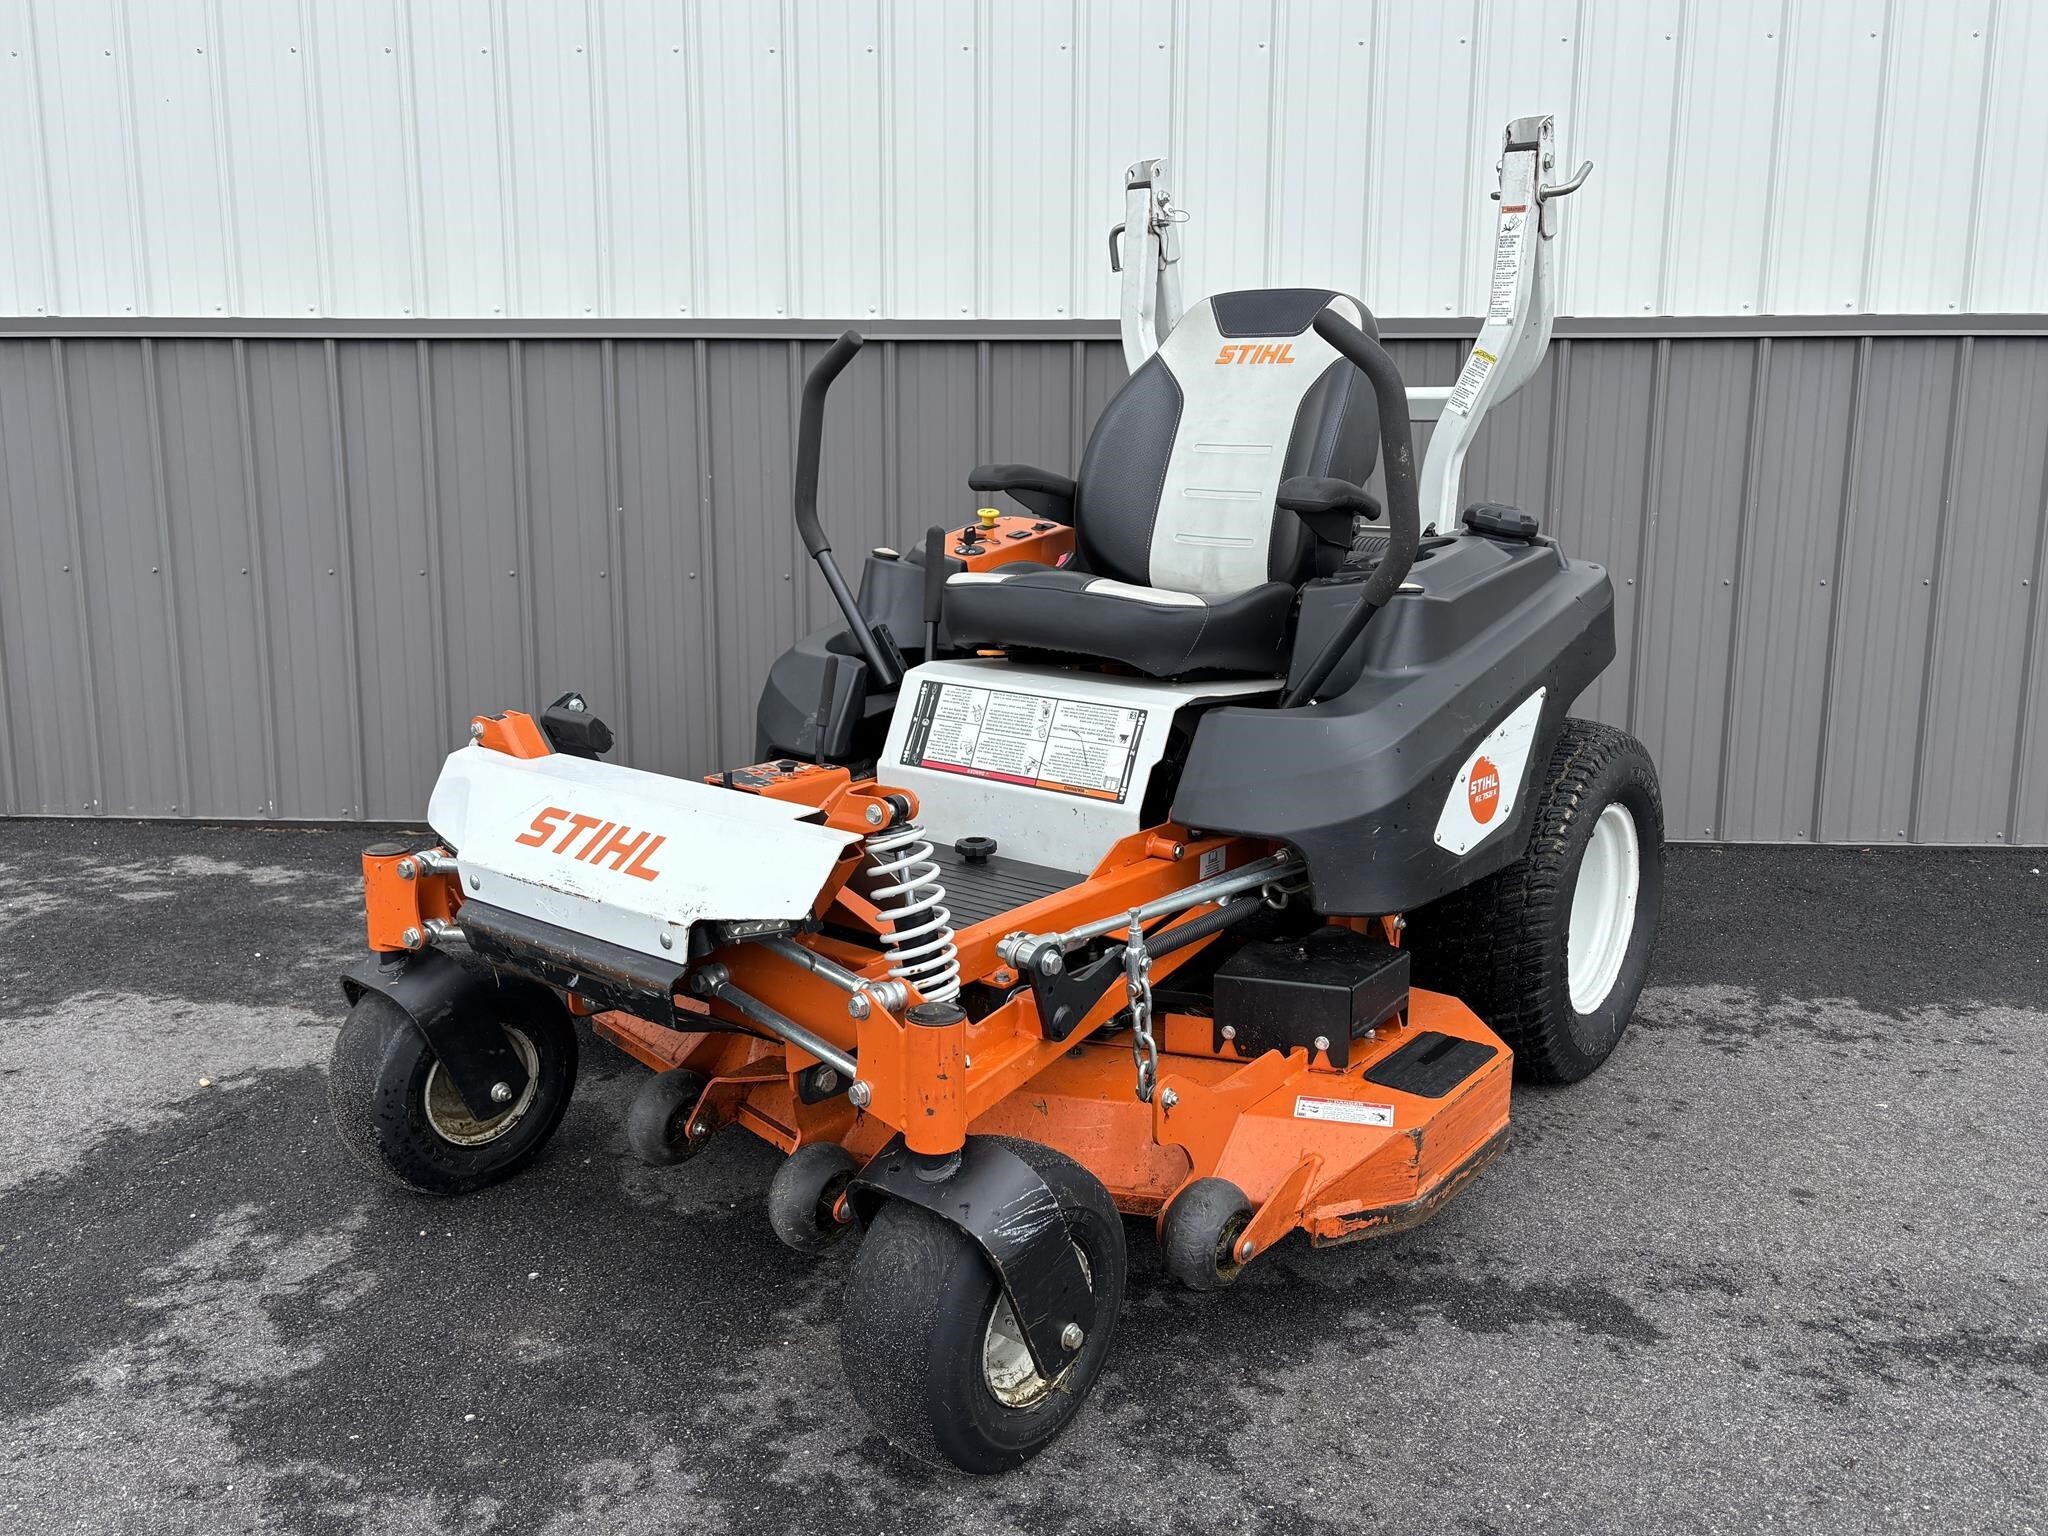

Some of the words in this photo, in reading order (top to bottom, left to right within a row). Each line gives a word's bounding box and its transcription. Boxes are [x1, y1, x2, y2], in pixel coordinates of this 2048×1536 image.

[1215, 344, 1295, 364] STIHL
[1471, 774, 1497, 795] STIHL
[515, 806, 667, 882] STIHL
